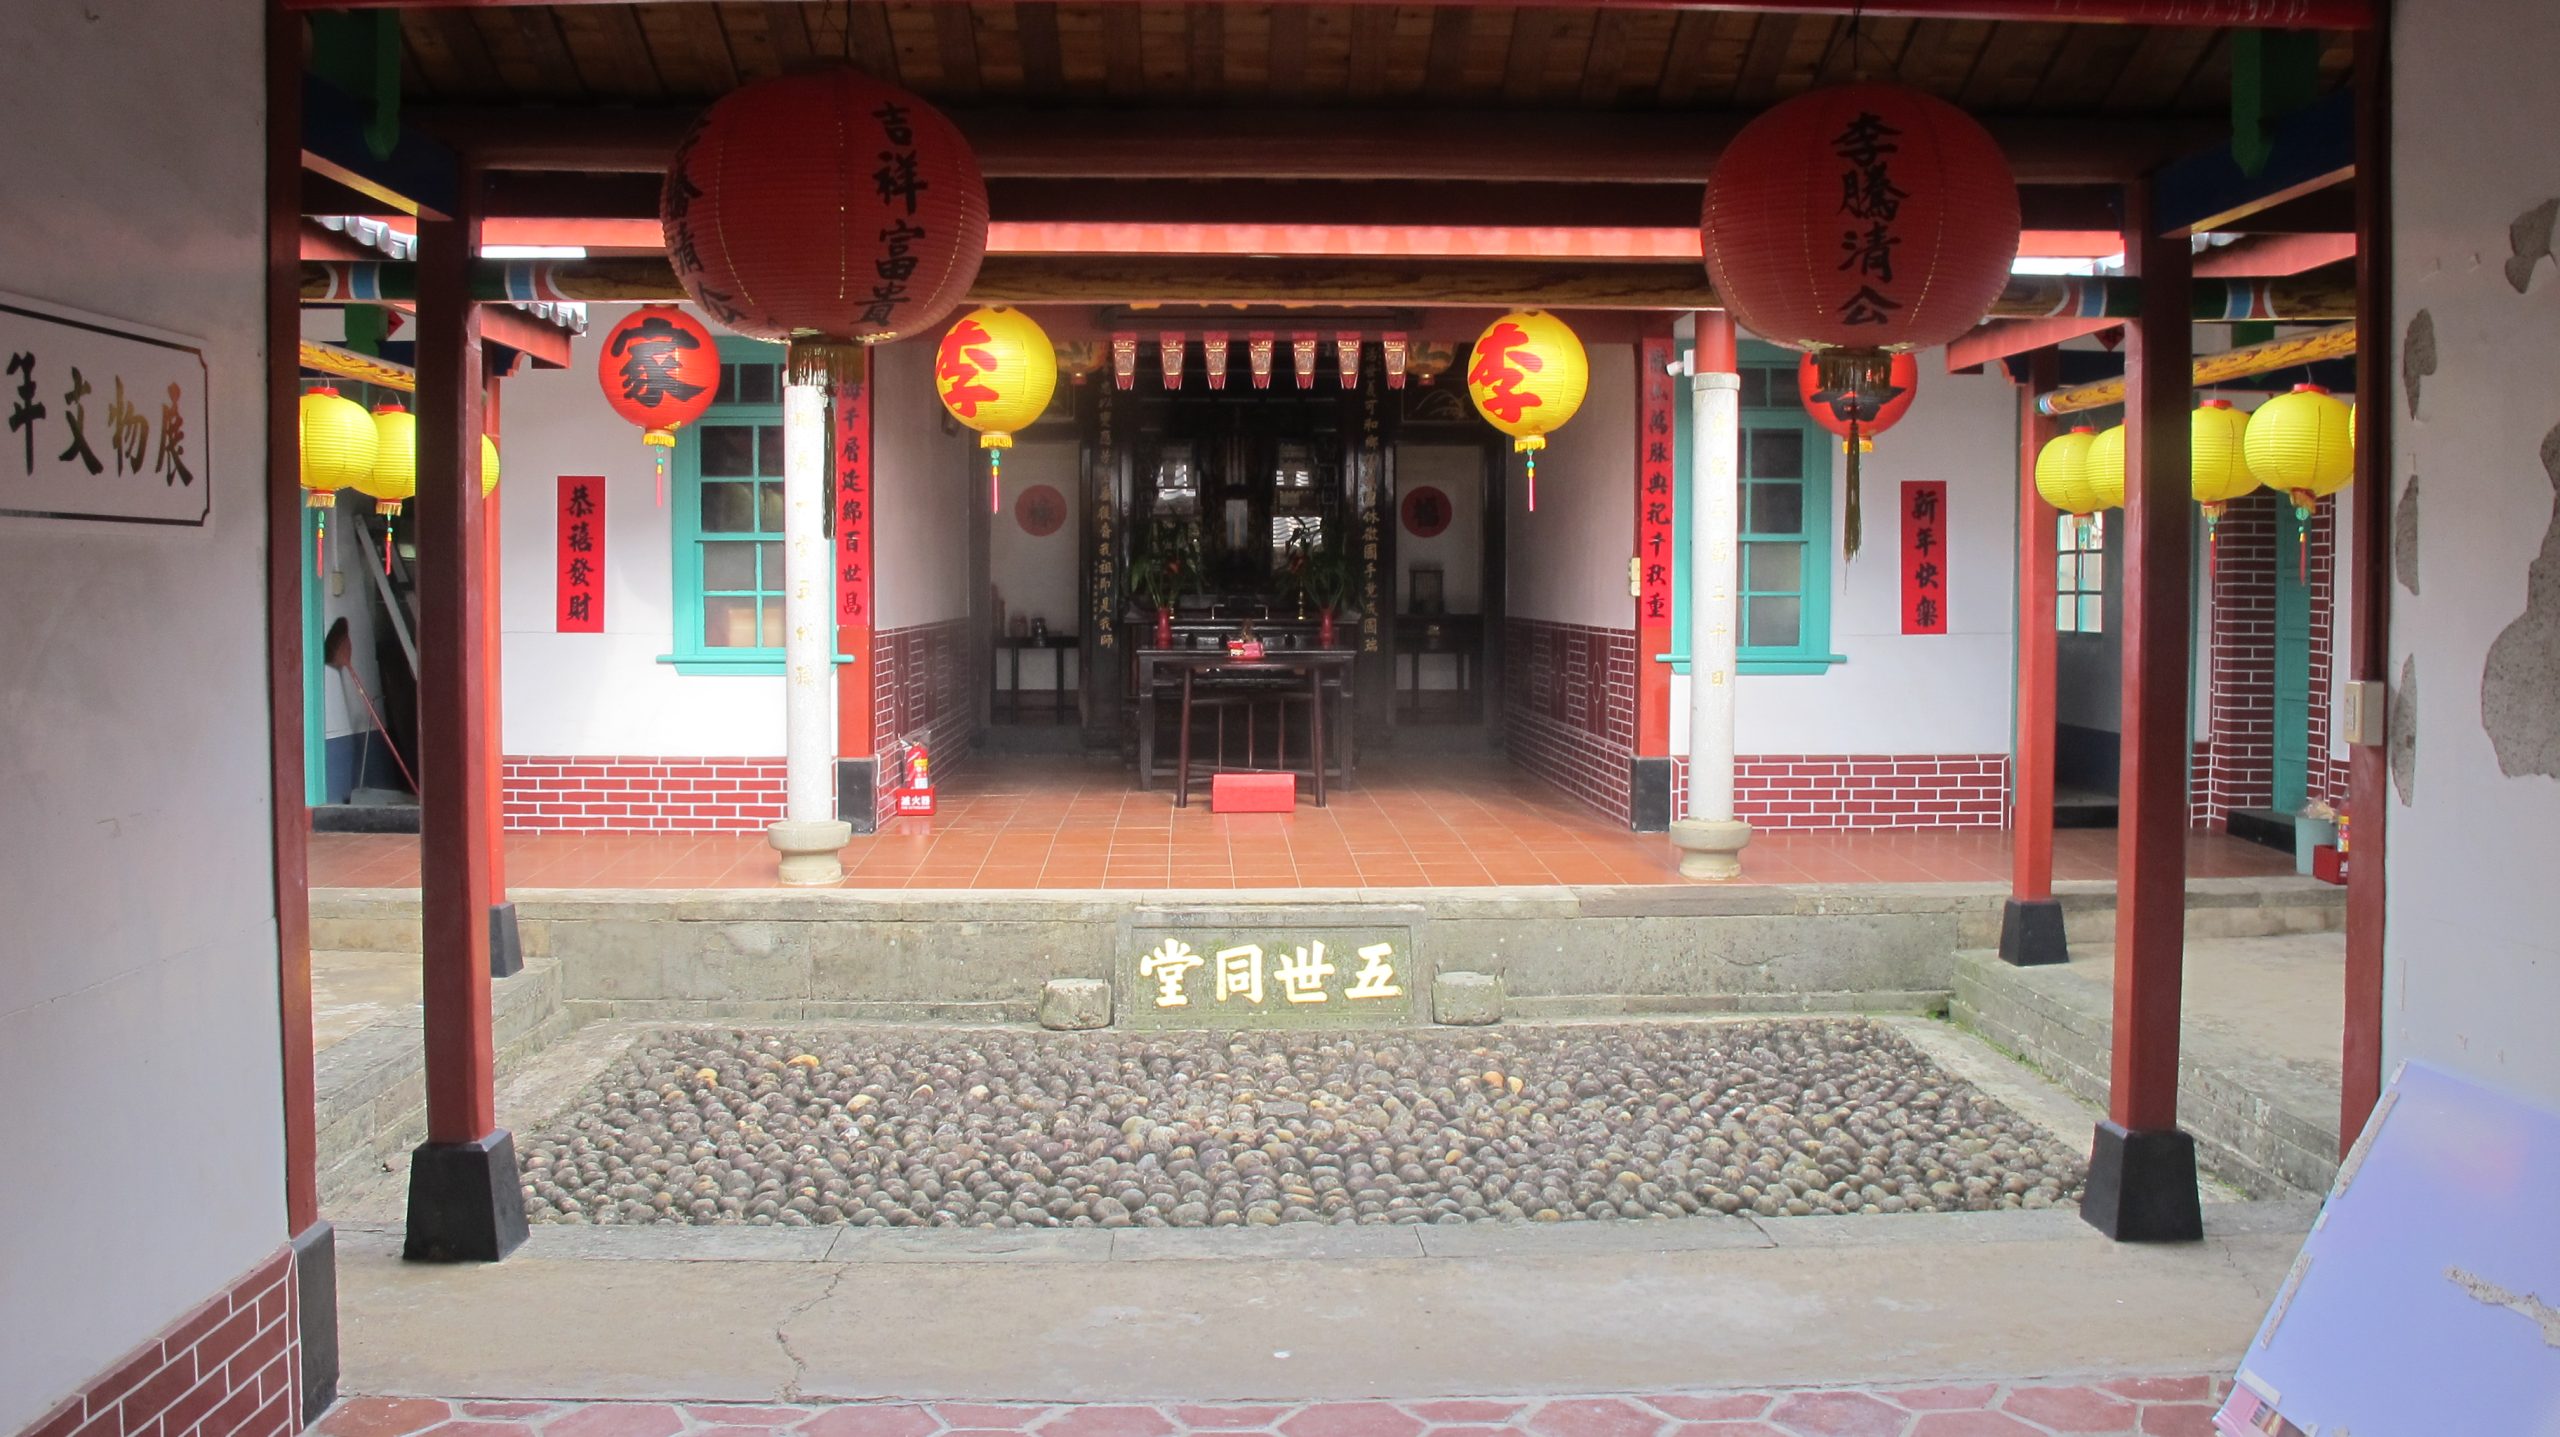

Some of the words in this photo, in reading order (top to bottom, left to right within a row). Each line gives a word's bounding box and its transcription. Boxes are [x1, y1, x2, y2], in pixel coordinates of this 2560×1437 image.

[850, 101, 928, 327] 吉祥富貴
[1831, 112, 1910, 325] 李騰清公
[610, 319, 707, 409] 家
[937, 320, 999, 416] 李
[1467, 322, 1542, 423] 李
[565, 485, 596, 624] 恭禧發財
[1911, 490, 1941, 627] 新年快樂
[900, 796, 931, 806] 滅火器
